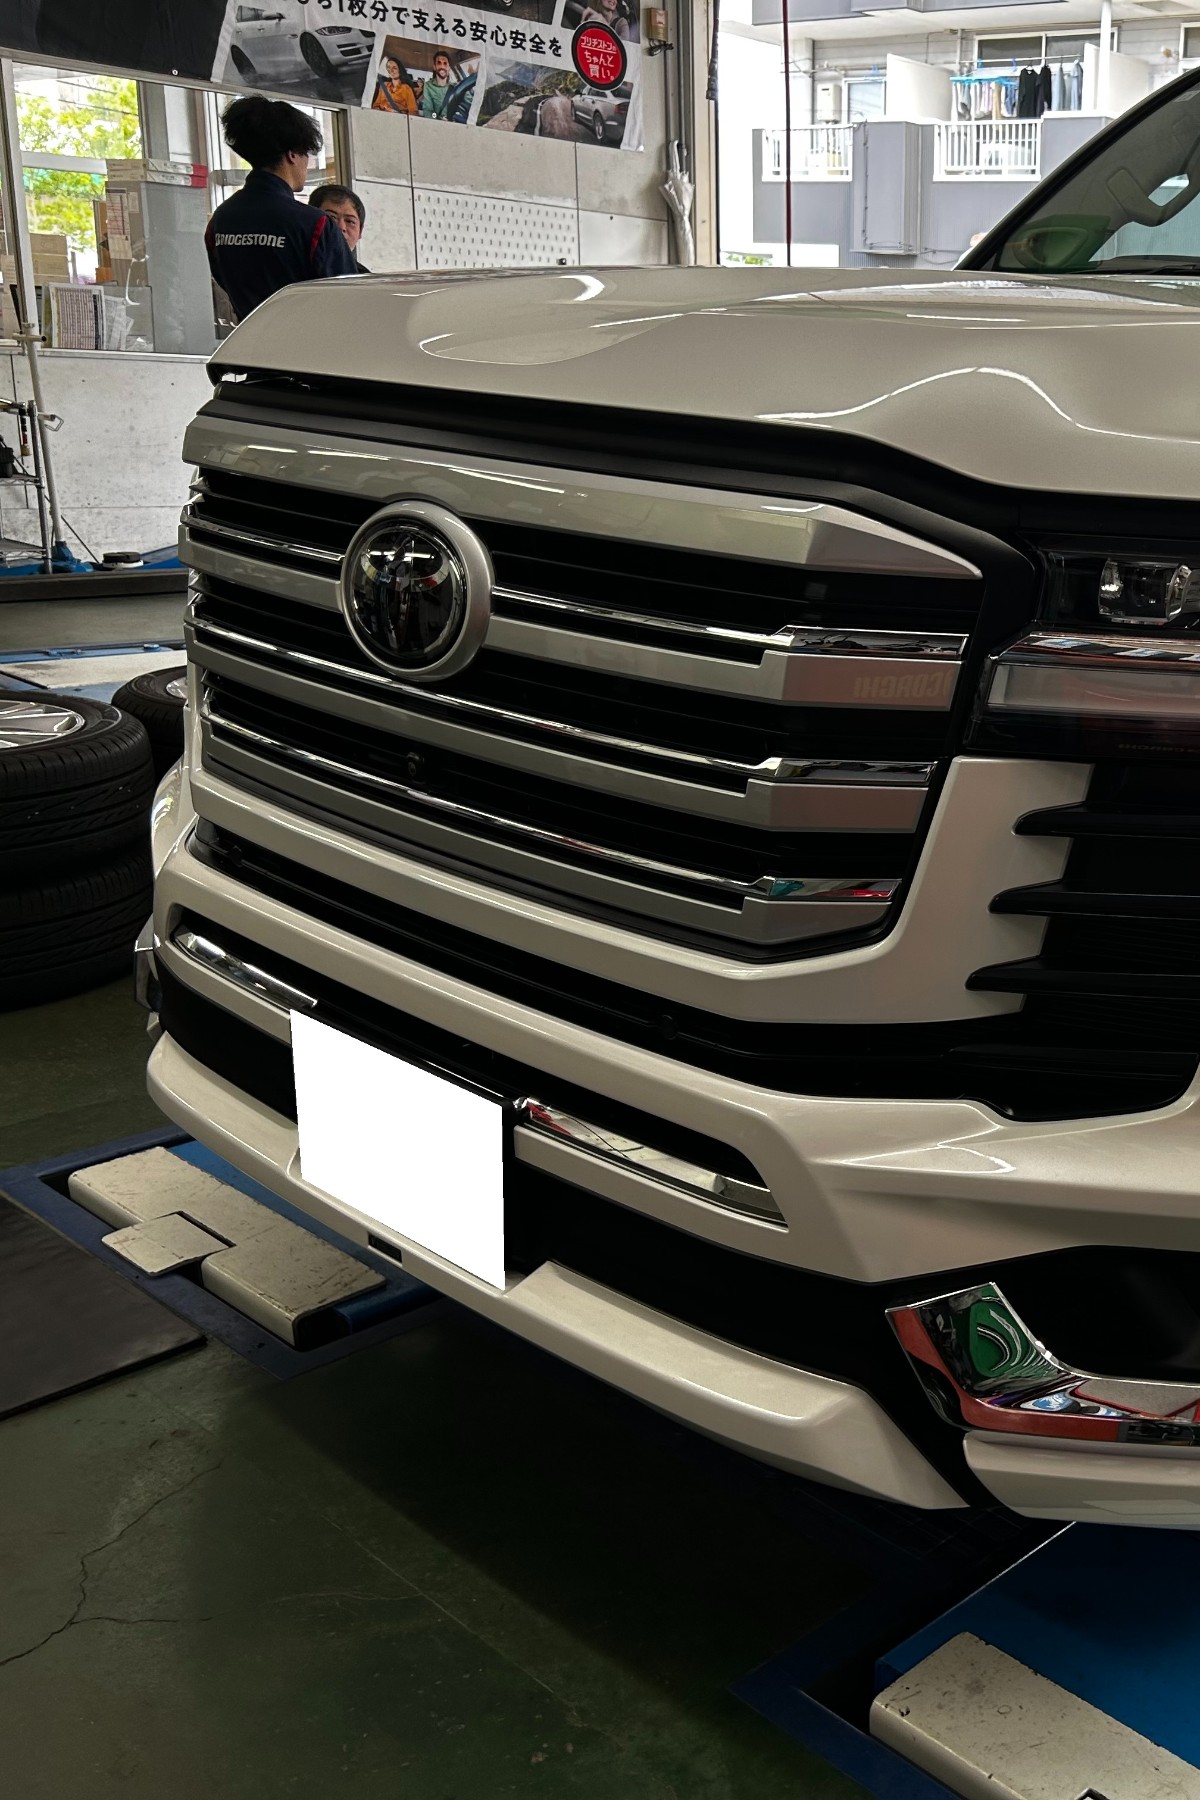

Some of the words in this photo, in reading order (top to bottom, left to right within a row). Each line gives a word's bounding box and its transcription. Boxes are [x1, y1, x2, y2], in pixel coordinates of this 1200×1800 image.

[297, 0, 562, 57] ら1枚分で支える安心安全を
[584, 50, 615, 67] ちゃんと
[215, 233, 286, 248] BRIDGESTONE
